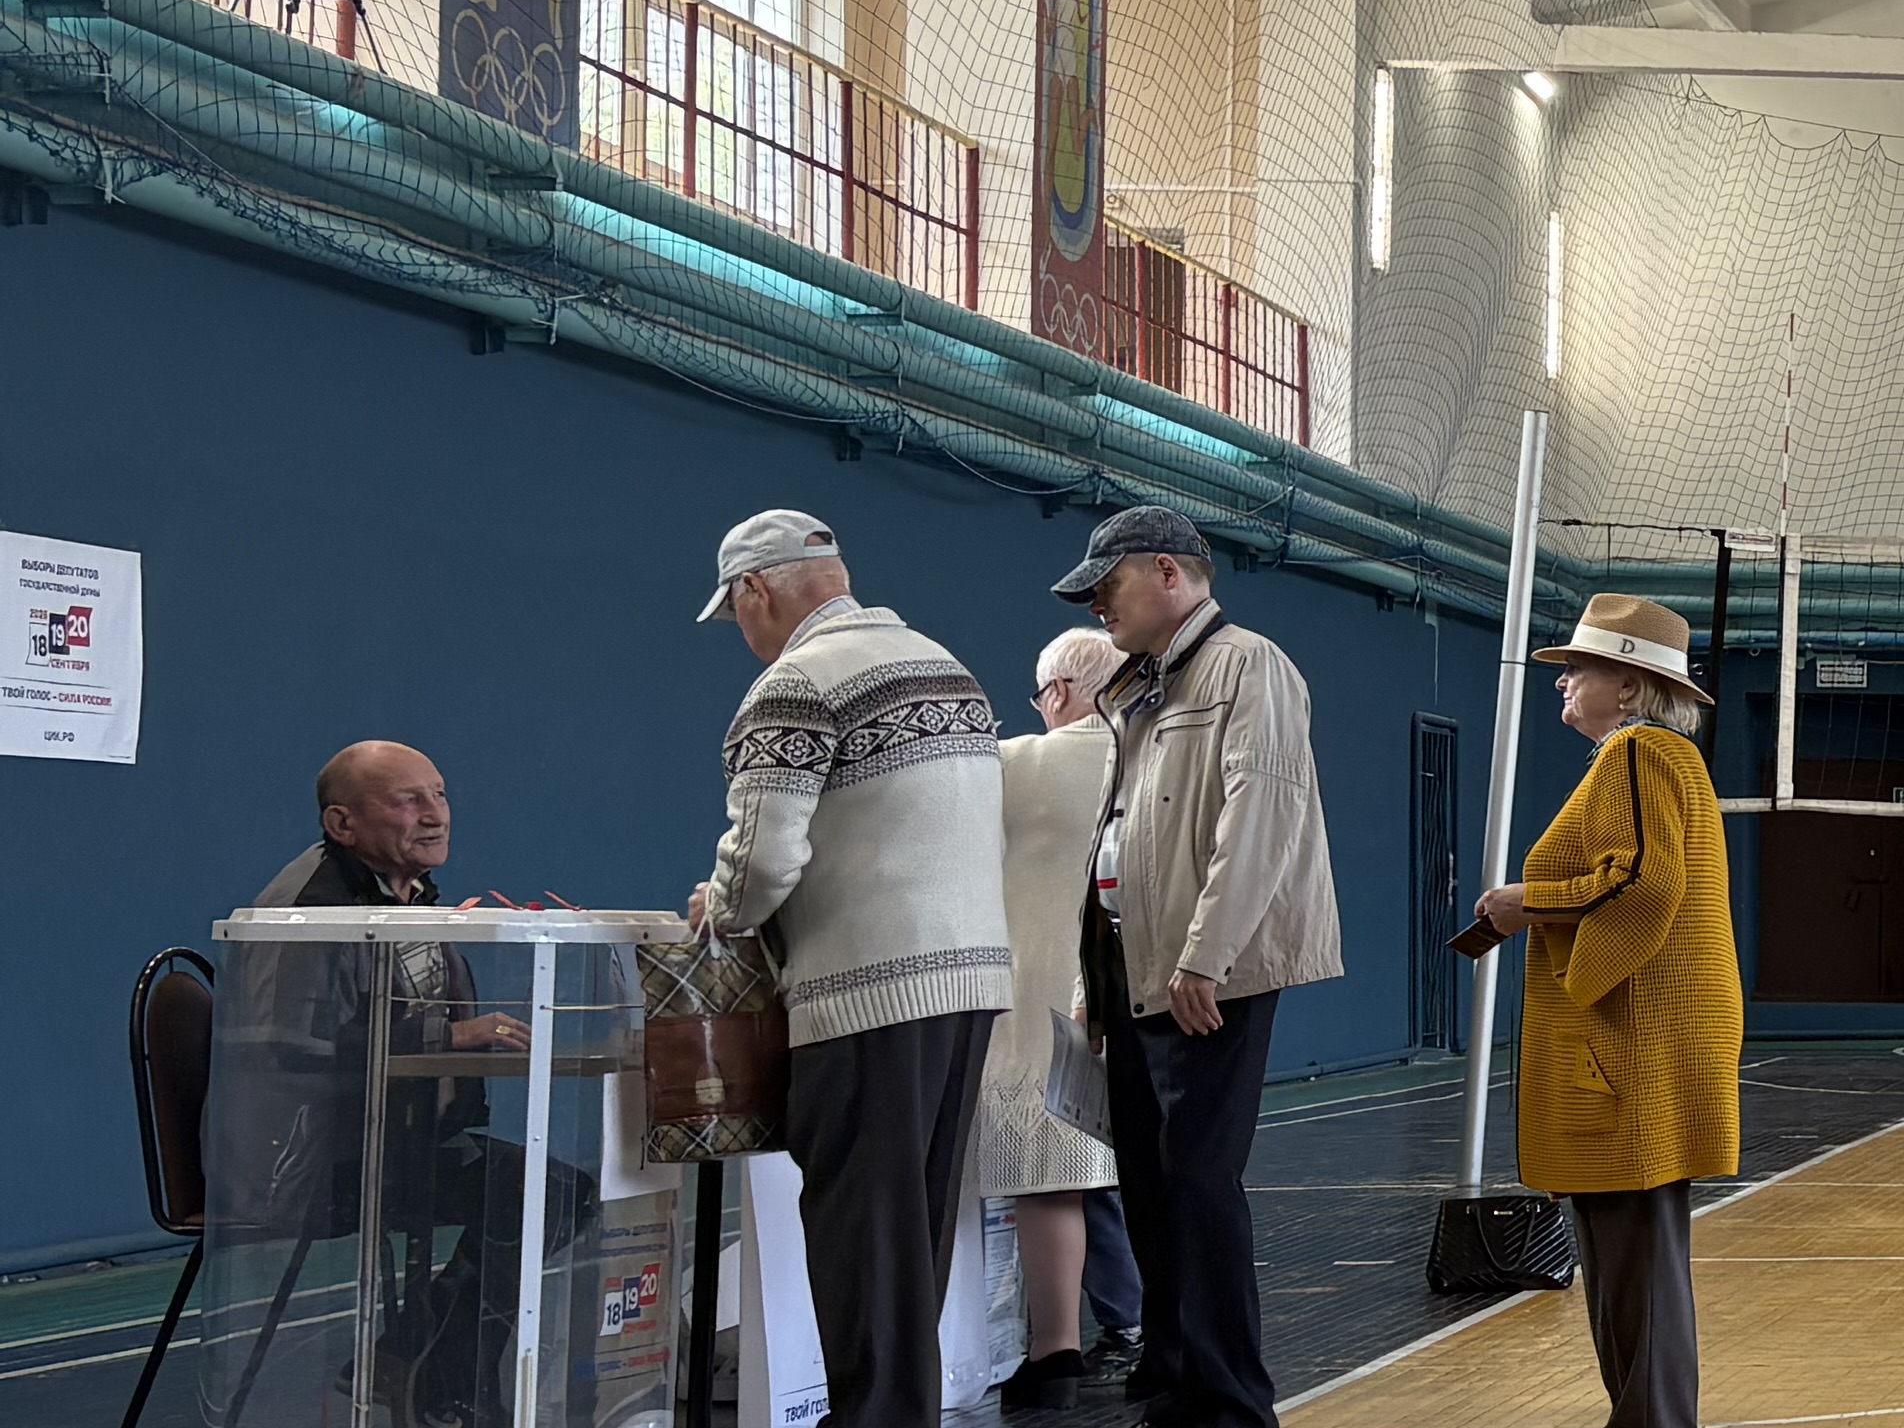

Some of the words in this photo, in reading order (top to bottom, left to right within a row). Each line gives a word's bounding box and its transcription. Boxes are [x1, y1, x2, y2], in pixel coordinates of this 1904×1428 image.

[32, 634, 47, 657] 18
[51, 623, 65, 647] 19
[68, 615, 88, 638] 20
[1619, 638, 1636, 654] D
[1, 686, 25, 699] ТВОЙ
[26, 689, 51, 701] ГОЛОС
[607, 1302, 621, 1327] 18
[625, 1286, 638, 1312] 19
[640, 1273, 657, 1299] 20
[784, 1398, 809, 1423] ТВОЙ
